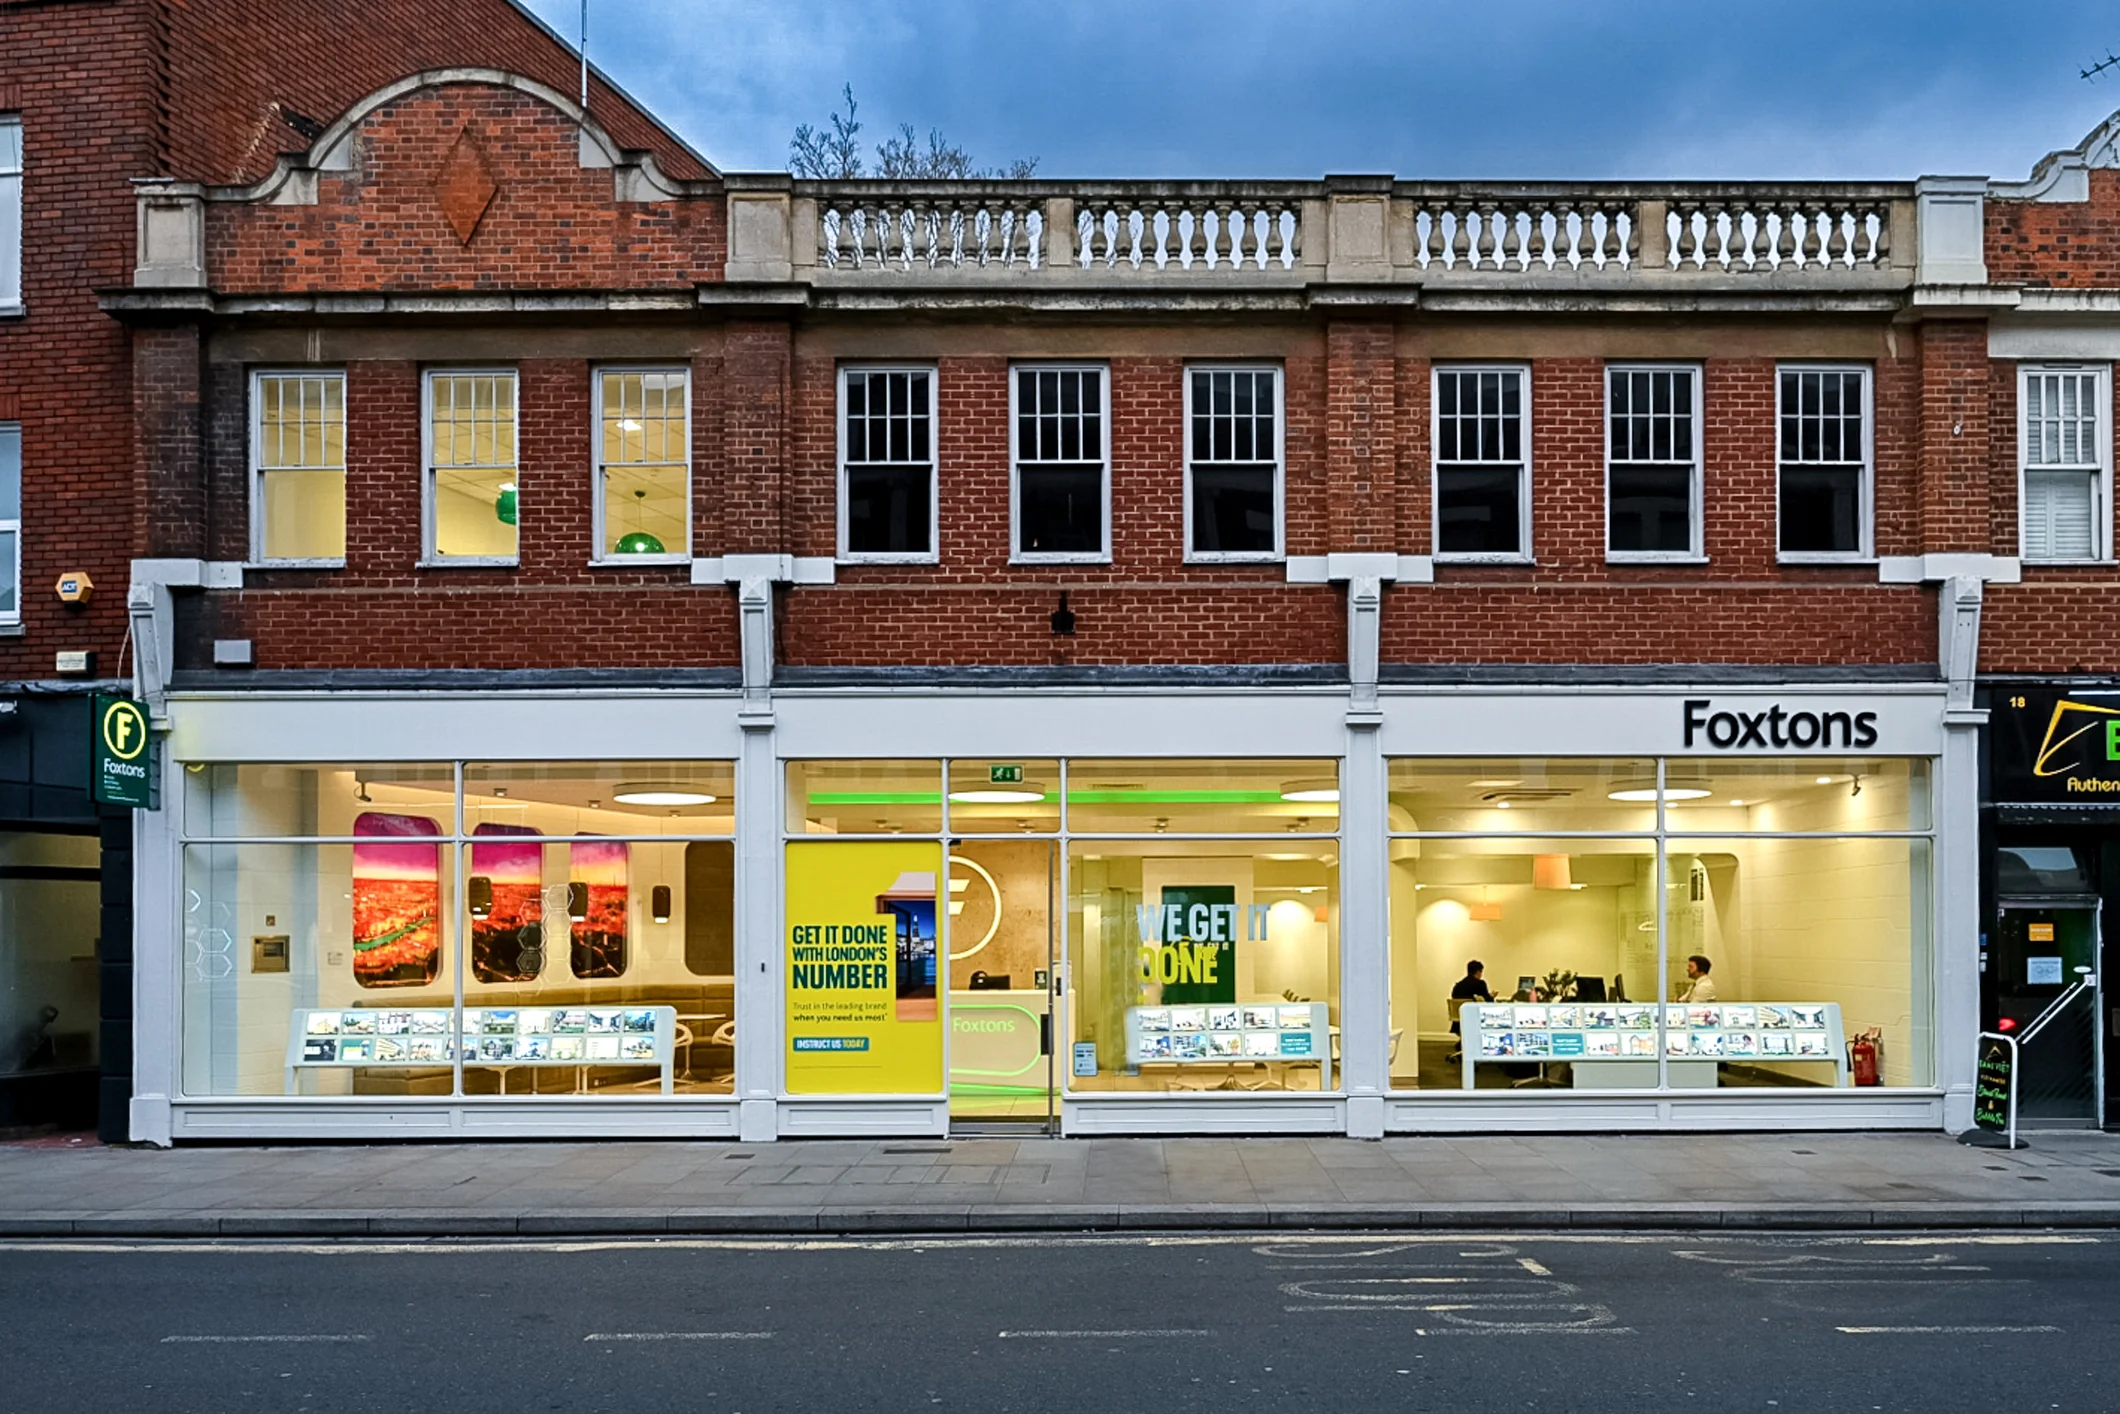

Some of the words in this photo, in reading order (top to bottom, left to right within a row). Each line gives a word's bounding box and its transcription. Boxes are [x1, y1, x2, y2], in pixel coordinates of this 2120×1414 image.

[2009, 696, 2026, 708] 18
[117, 711, 134, 750] F
[1683, 699, 1878, 748] Foxtons
[103, 757, 145, 779] Foxtons
[1136, 903, 1182, 942] WE
[1188, 903, 1241, 942] GET
[1248, 904, 1271, 941] IT
[792, 925, 822, 945] GET
[826, 925, 839, 945] IT
[842, 925, 887, 945] DONE
[792, 947, 823, 962] WITH
[826, 947, 887, 962] LONDON'S
[1137, 945, 1218, 985] DONE
[792, 964, 887, 989] NUMBER
[793, 1002, 812, 1011] Trust
[814, 1002, 821, 1011] in
[822, 1002, 834, 1011] the
[836, 1002, 863, 1012] leading
[865, 1002, 887, 1011] brand
[793, 1013, 814, 1022] when
[816, 1015, 831, 1024] you
[833, 1013, 852, 1022] need
[952, 1016, 1016, 1033] Foxtons
[831, 1039, 841, 1049] US
